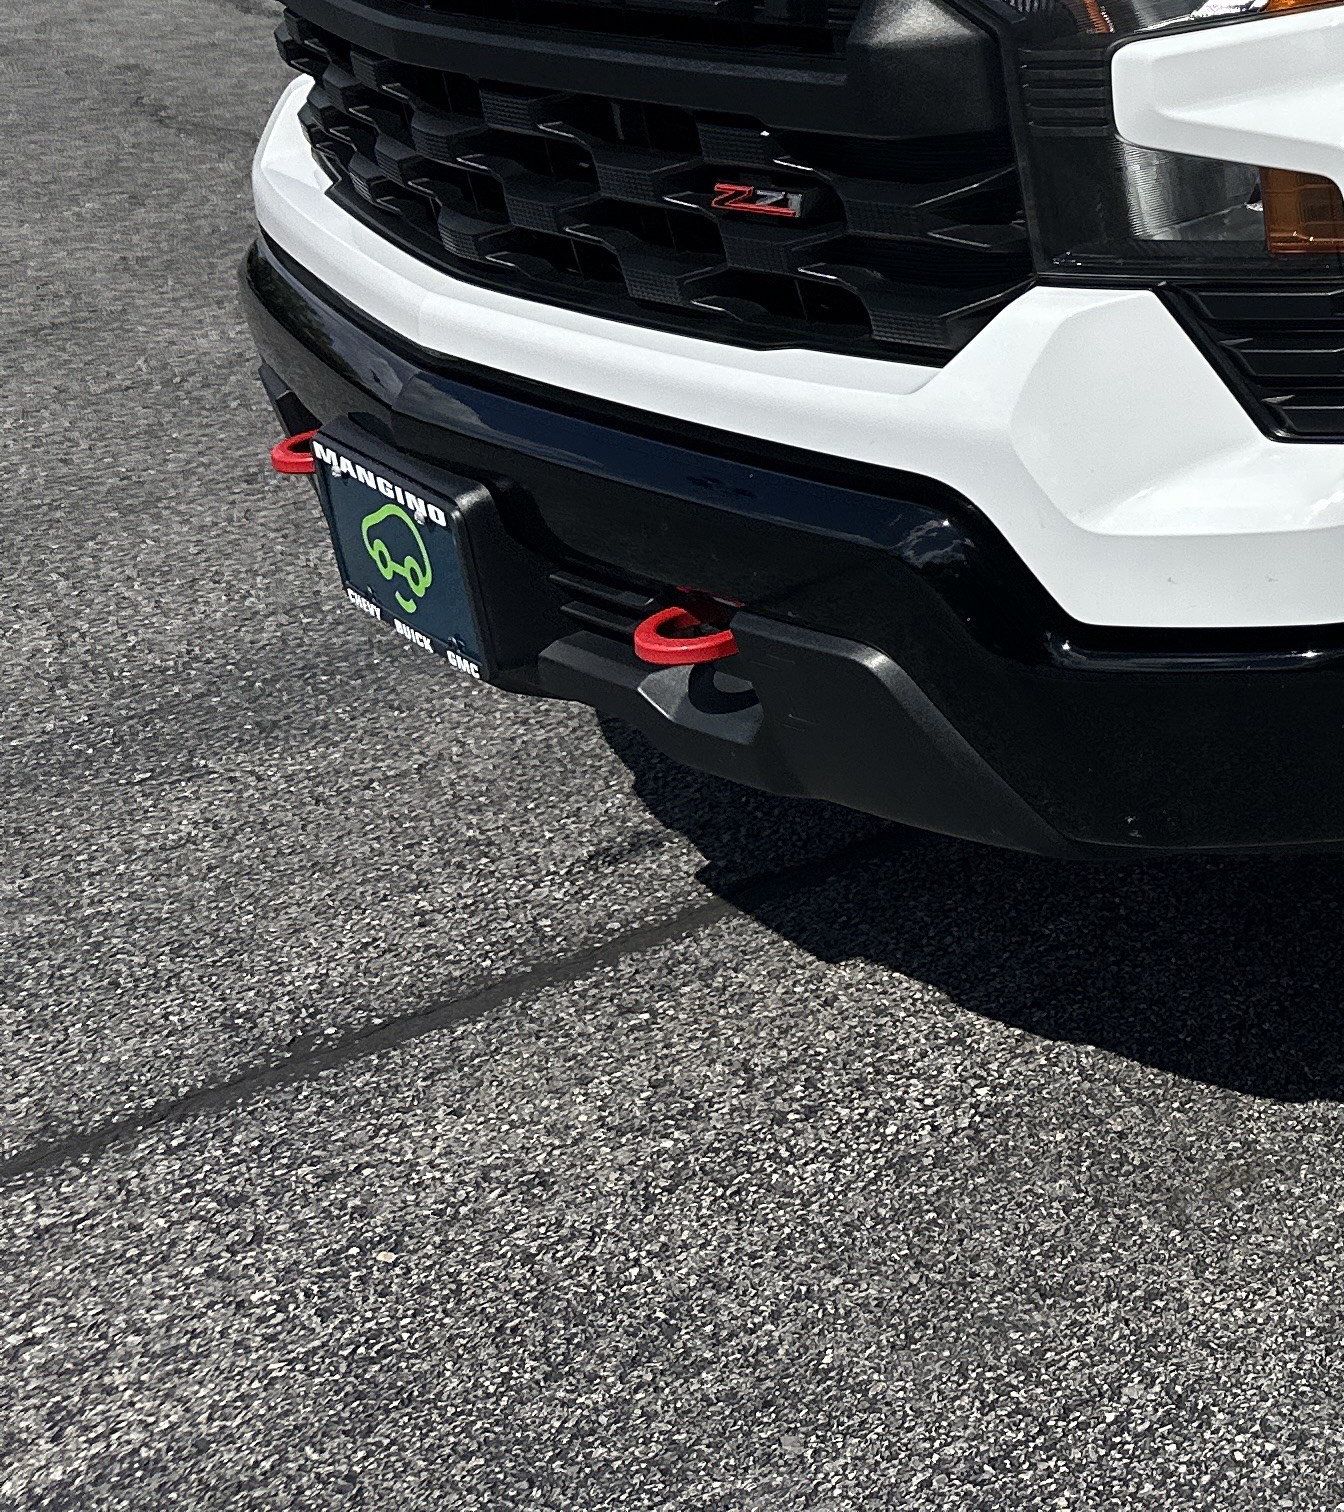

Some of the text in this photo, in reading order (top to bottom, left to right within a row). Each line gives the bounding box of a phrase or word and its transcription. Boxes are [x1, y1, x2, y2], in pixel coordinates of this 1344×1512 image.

[711, 182, 802, 218] Z71
[312, 440, 447, 527] MANGINO
[347, 588, 480, 679] CHEVY BUICK GMC
